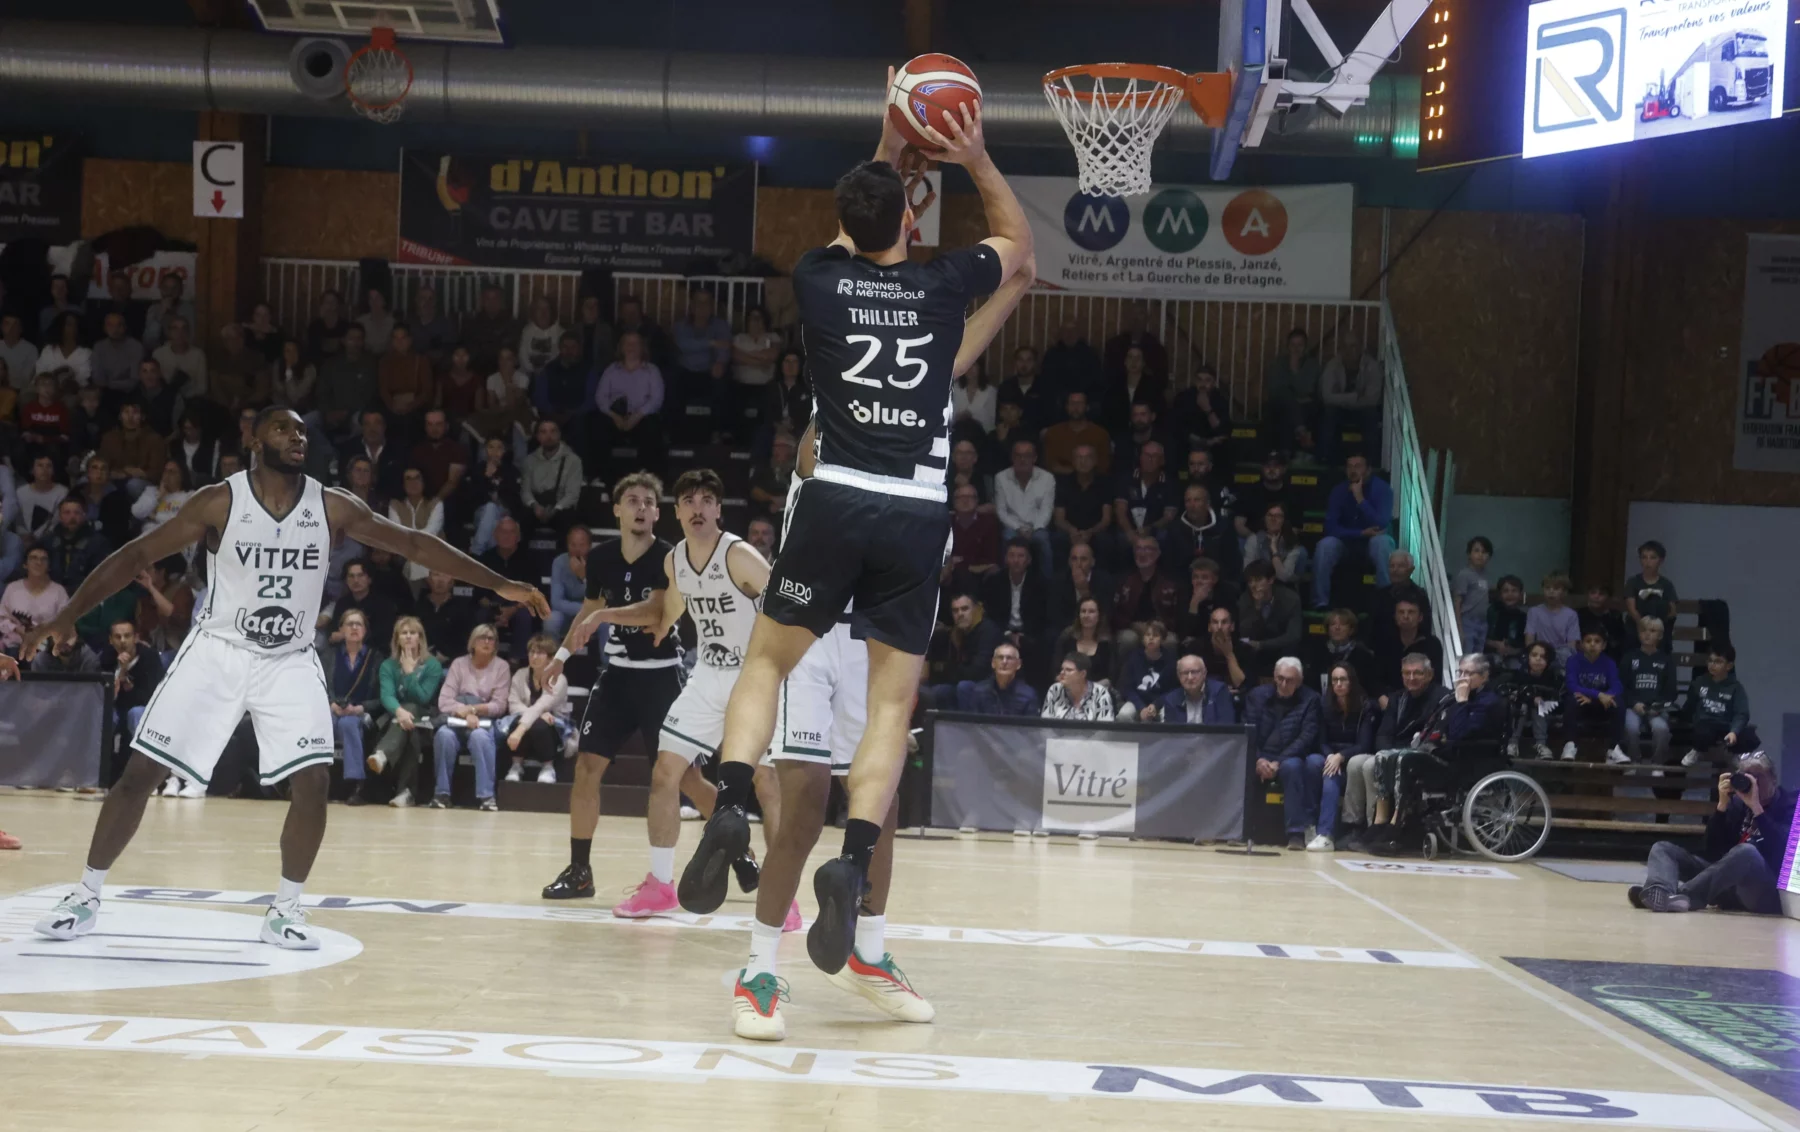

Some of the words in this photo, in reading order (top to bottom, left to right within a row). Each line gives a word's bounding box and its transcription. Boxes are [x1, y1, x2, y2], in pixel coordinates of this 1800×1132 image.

[1640, 18, 1704, 41] Transportons
[1708, 12, 1726, 24] vos
[1730, 1, 1772, 18] valeurs
[201, 144, 235, 186] C
[490, 159, 726, 199] d'Anthon'
[489, 207, 580, 232] CAVE
[592, 210, 634, 234] ET
[645, 213, 714, 237] BAR
[1240, 206, 1270, 238] A
[1068, 253, 1103, 267] Vitré,
[1106, 254, 1163, 269] Argentré
[1167, 256, 1183, 268] du
[1187, 257, 1236, 271] Plessis,
[1240, 258, 1282, 272] Janzé,
[1062, 269, 1108, 281] Retiers
[1112, 270, 1125, 281] et
[1128, 271, 1144, 282] La
[1148, 271, 1201, 284] Guerche
[1204, 272, 1220, 284] de
[1224, 274, 1287, 288] Bretagne.
[848, 307, 919, 327] THILLIER
[841, 332, 934, 390] 25
[235, 540, 262, 548] Aurore
[257, 575, 293, 599] 23
[624, 586, 632, 602] 8
[235, 607, 305, 639] lactel
[699, 619, 725, 638] 26
[583, 720, 592, 735] 8
[792, 730, 822, 742] VITRÉ
[1053, 762, 1127, 798] Vitré
[0, 1013, 960, 1081] MAISONS
[1087, 1064, 1639, 1119] MTB
